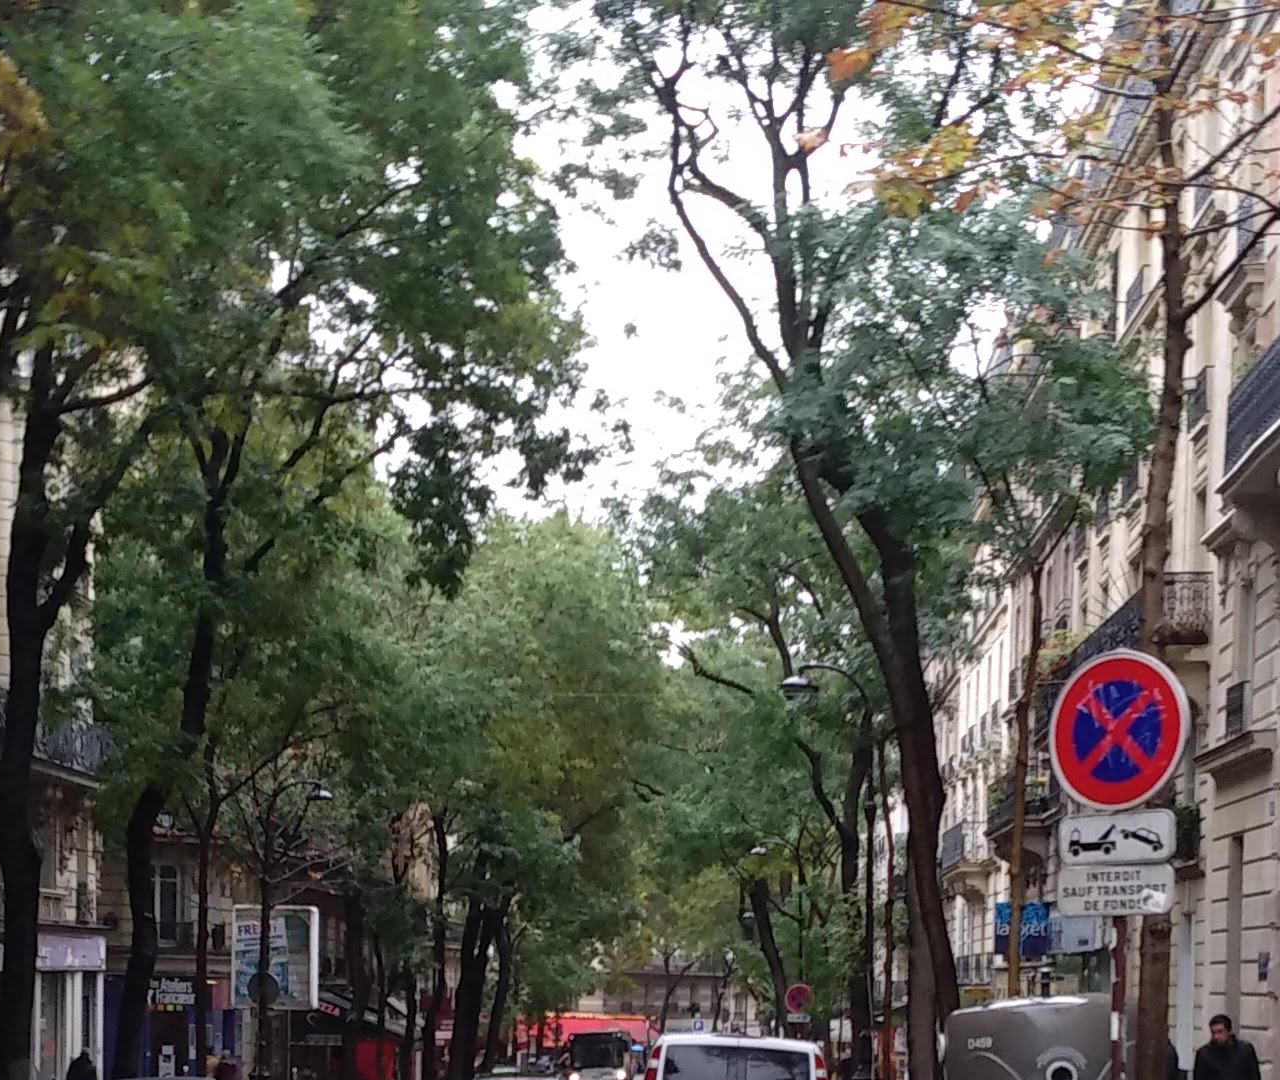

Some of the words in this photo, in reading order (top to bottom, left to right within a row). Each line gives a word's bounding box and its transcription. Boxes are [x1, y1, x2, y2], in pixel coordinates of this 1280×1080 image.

[1086, 870, 1141, 882] INTERDIT
[1062, 886, 1093, 898] SAUF
[1084, 900, 1100, 911] DE
